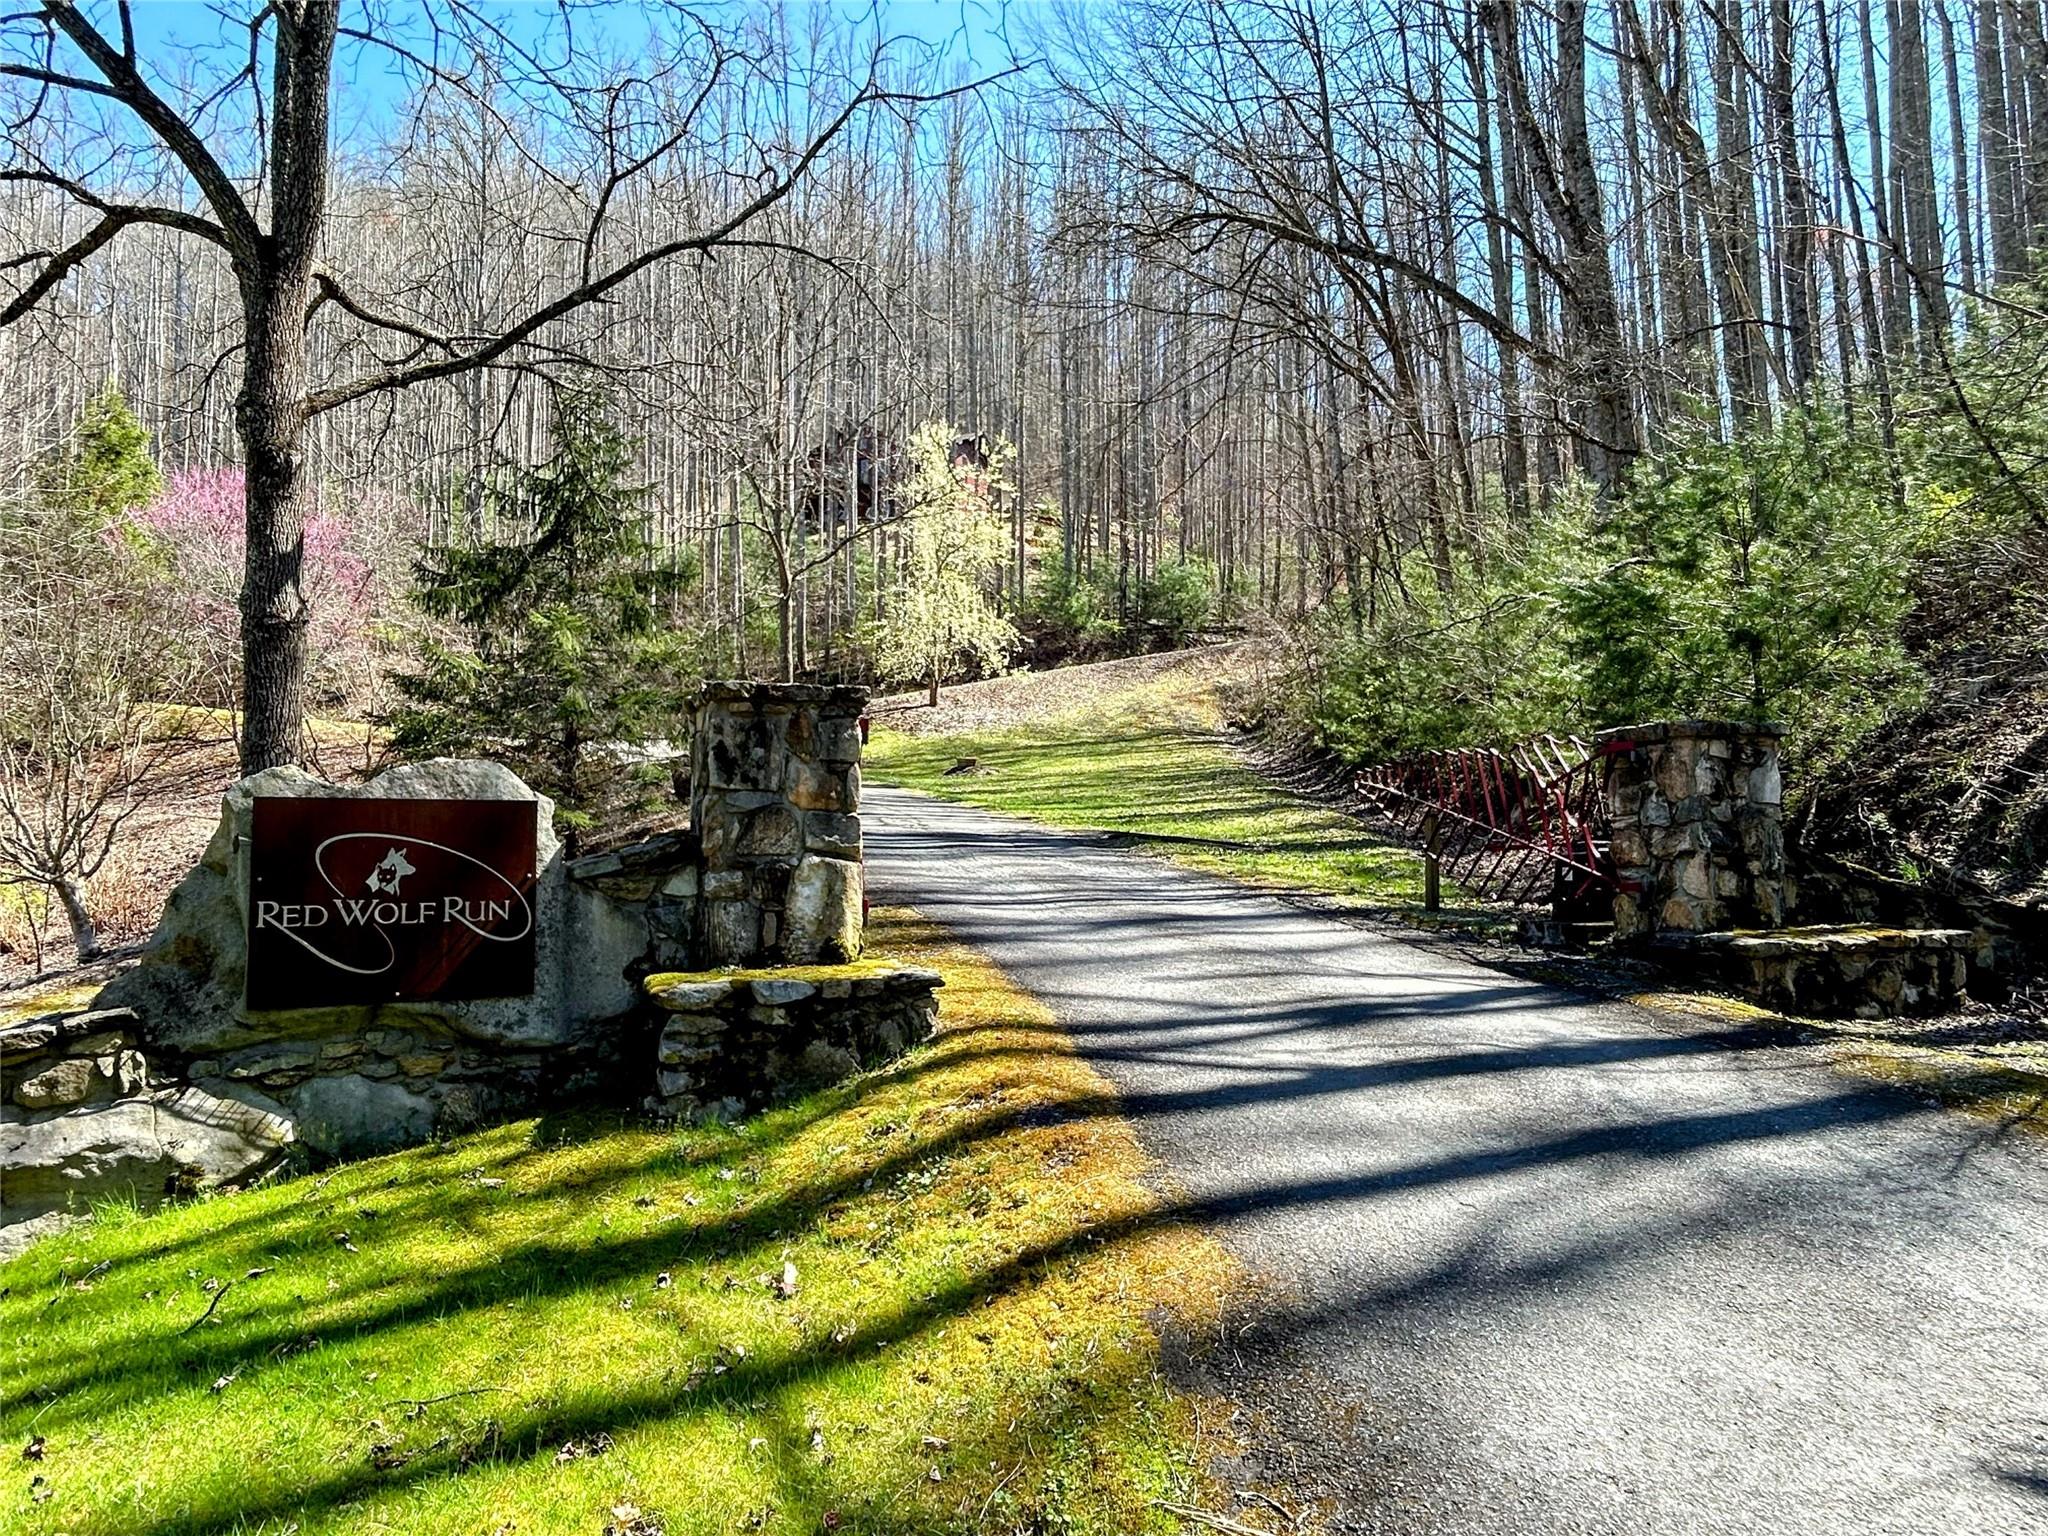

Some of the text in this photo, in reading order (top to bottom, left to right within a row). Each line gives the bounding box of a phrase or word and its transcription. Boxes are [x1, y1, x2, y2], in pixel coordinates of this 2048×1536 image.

[256, 896, 510, 929] RED WOLF RUN
